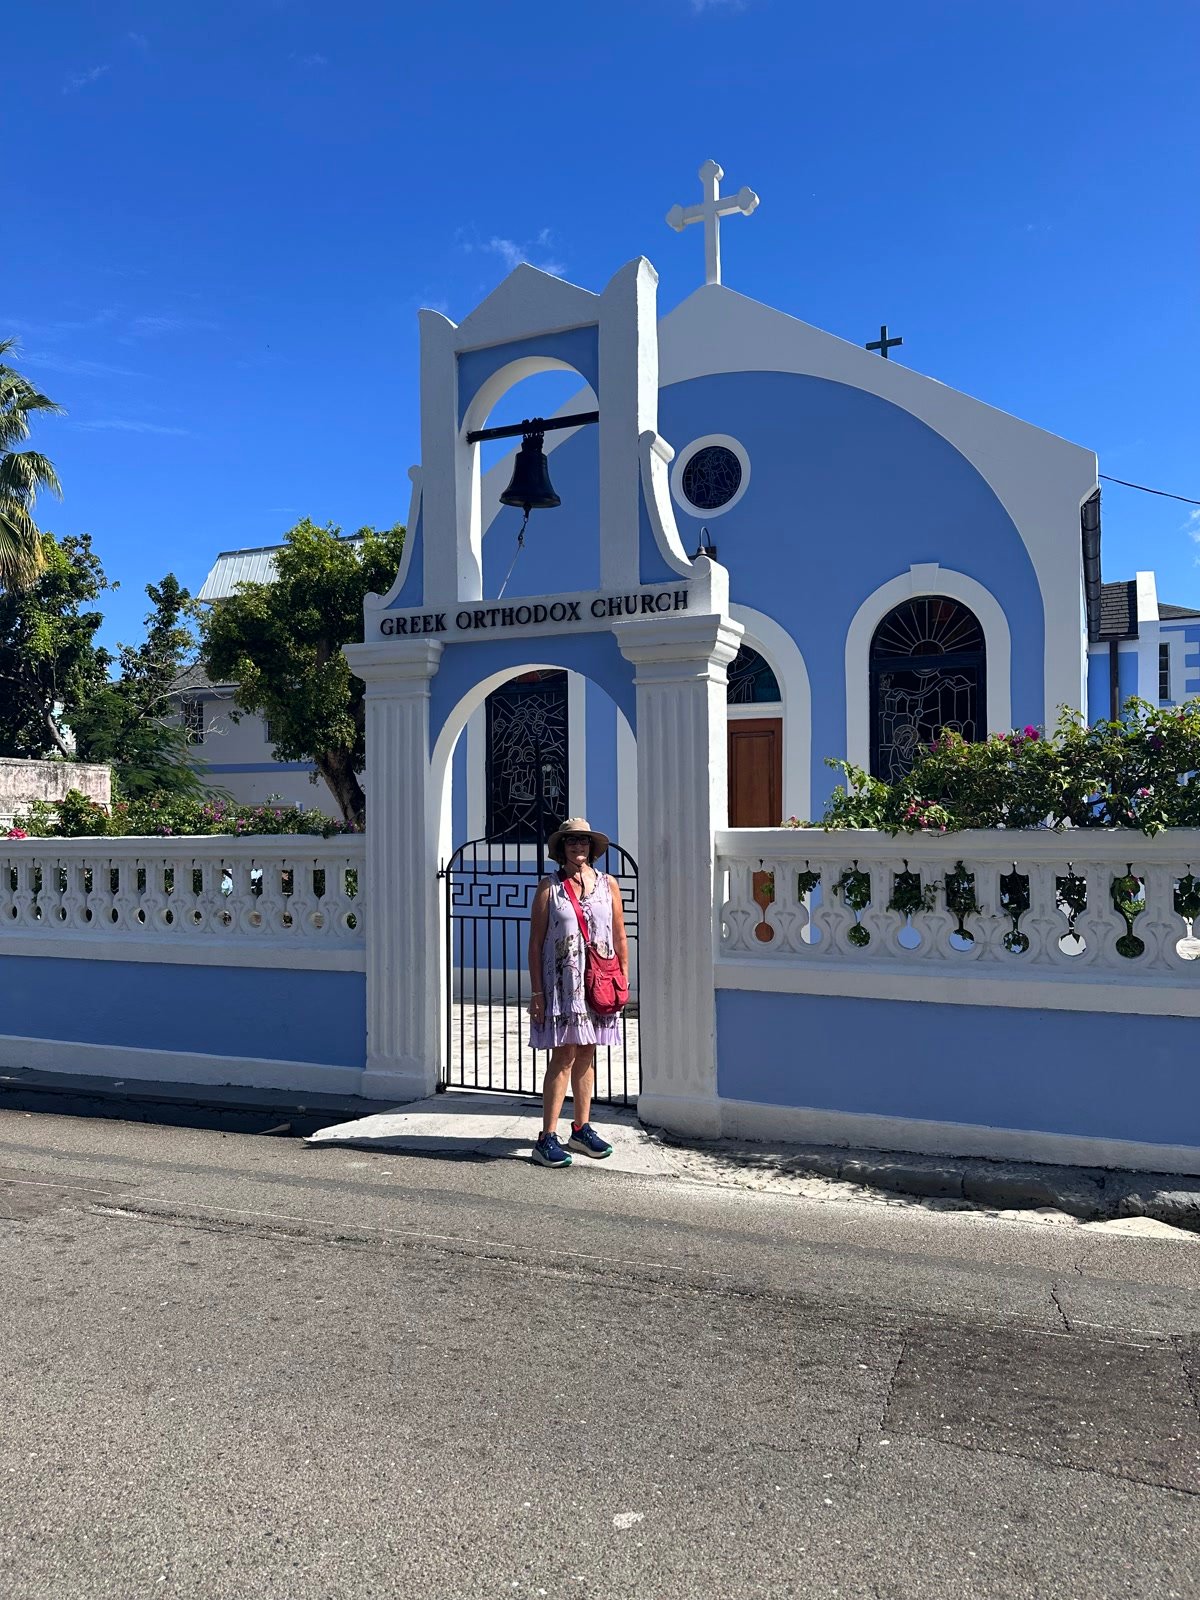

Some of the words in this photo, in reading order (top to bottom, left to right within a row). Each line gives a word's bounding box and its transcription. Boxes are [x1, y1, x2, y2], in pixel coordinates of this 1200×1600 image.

[380, 613, 447, 636] GREEK
[456, 602, 582, 630] ORTHODOX
[591, 590, 689, 618] CHURCH
